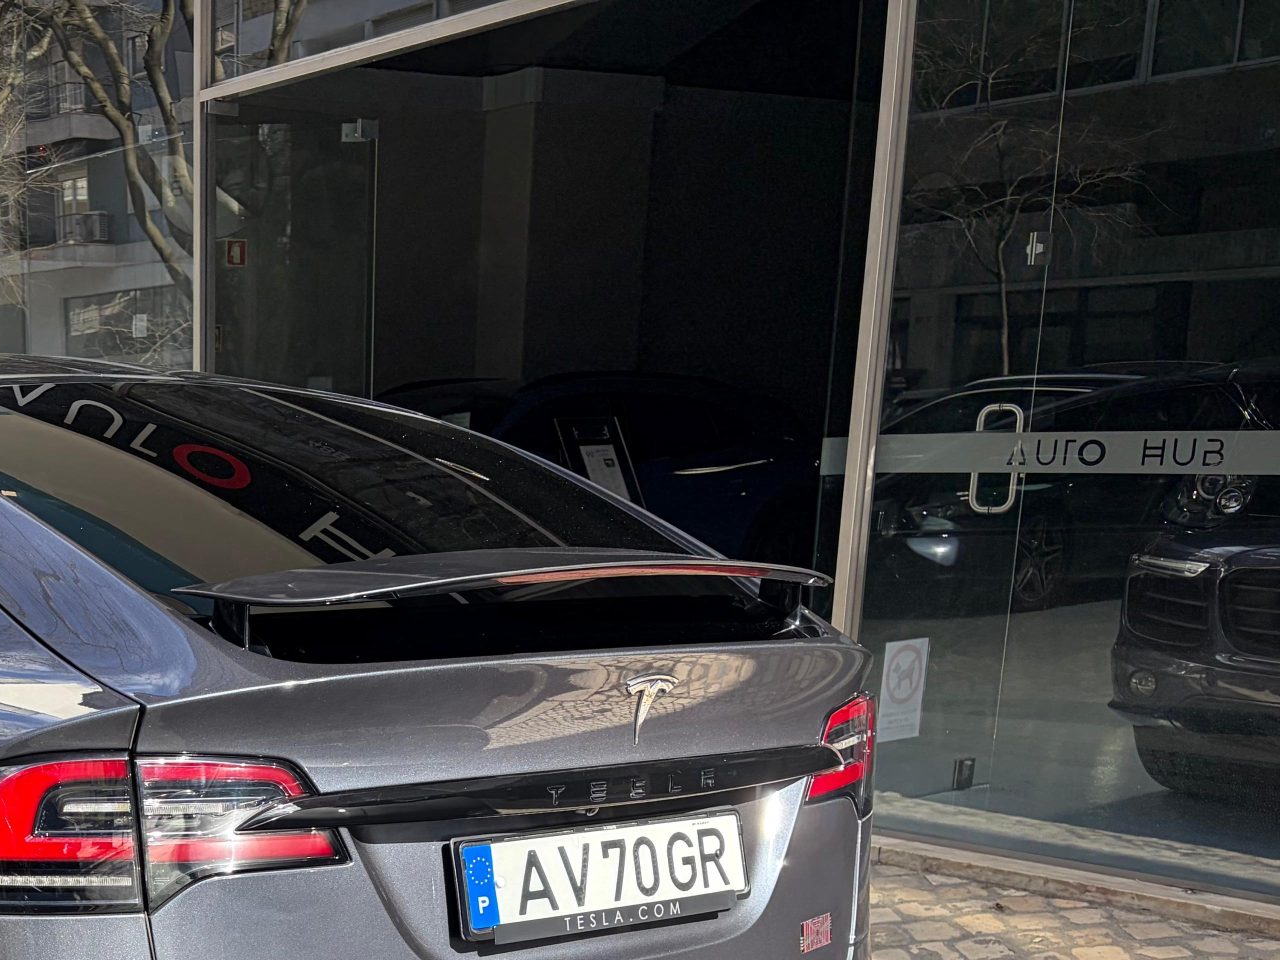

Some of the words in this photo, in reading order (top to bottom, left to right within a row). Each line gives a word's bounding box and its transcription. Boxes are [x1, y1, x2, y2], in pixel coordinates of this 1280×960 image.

[1140, 437, 1225, 467] HUB
[477, 895, 491, 914] P
[564, 900, 682, 931] TESLA.COM
